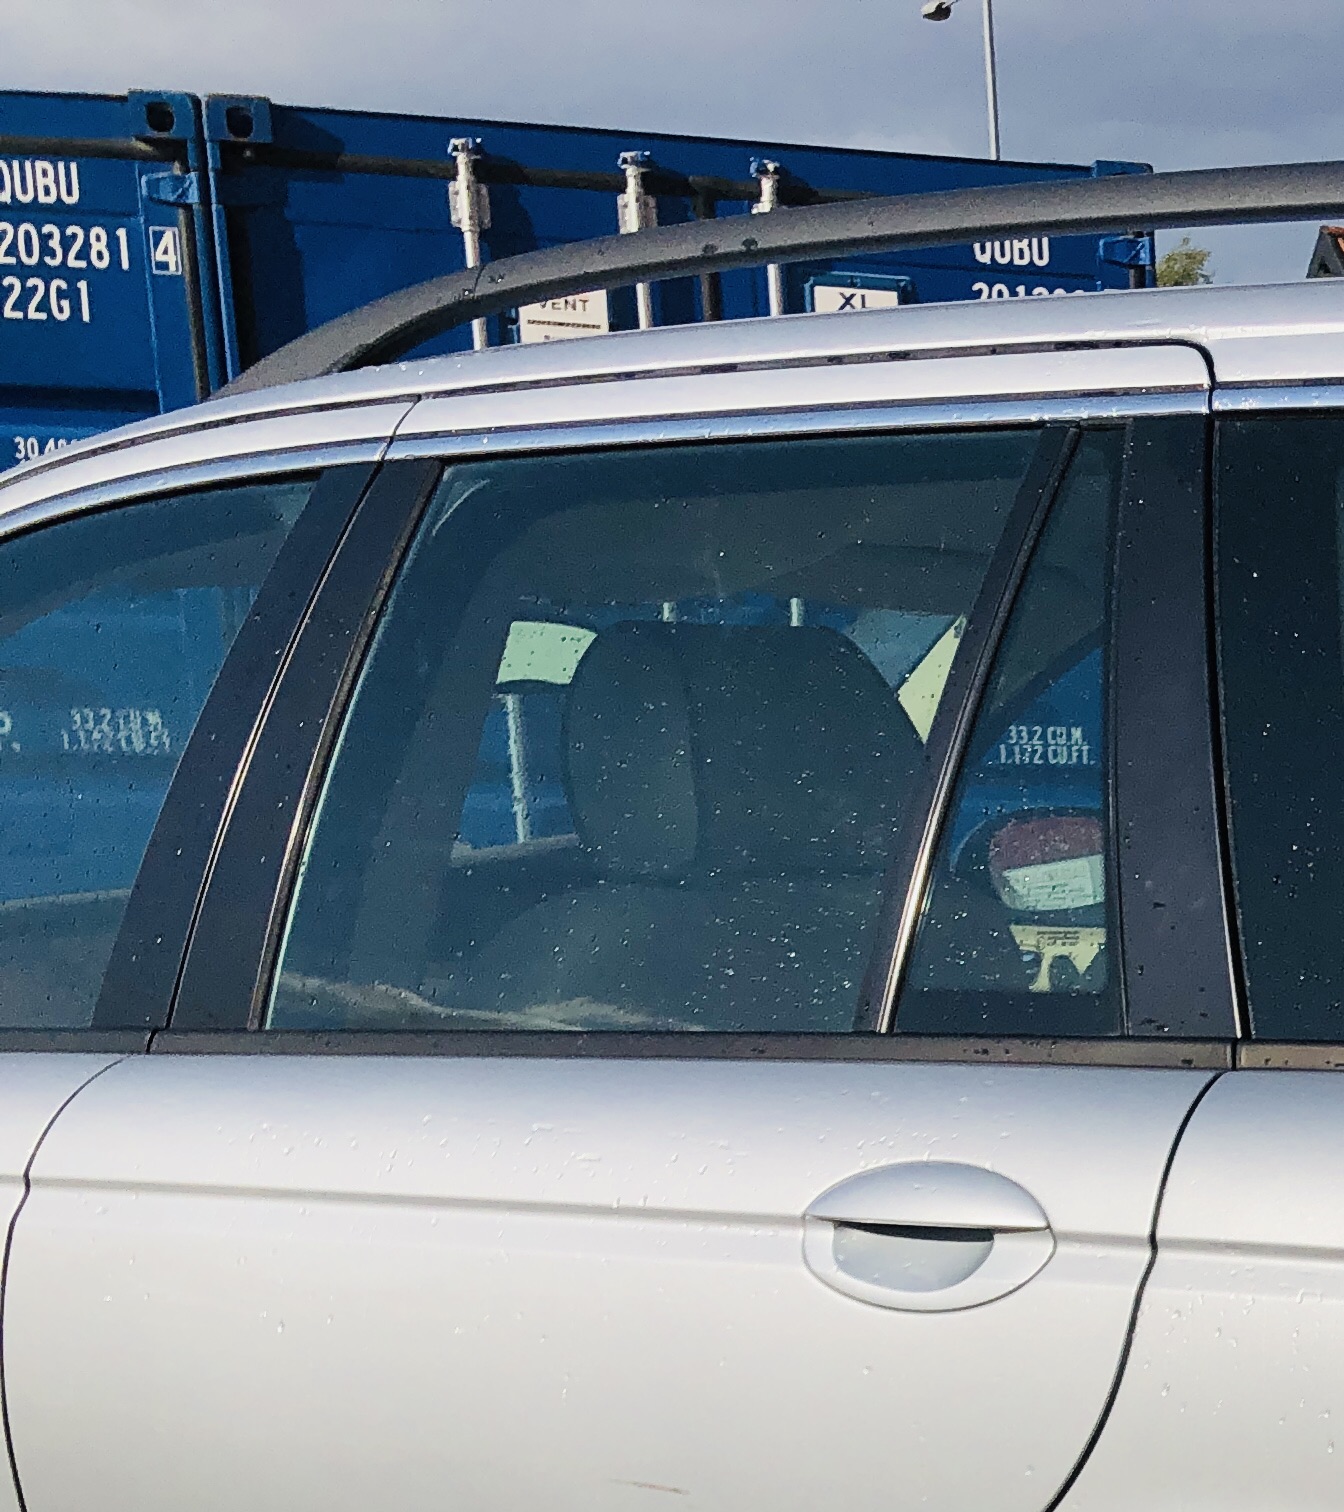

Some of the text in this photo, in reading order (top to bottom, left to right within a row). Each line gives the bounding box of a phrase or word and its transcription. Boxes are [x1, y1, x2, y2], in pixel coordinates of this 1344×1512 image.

[0, 221, 177, 272] 203281 4
[2, 275, 91, 323] 22G1
